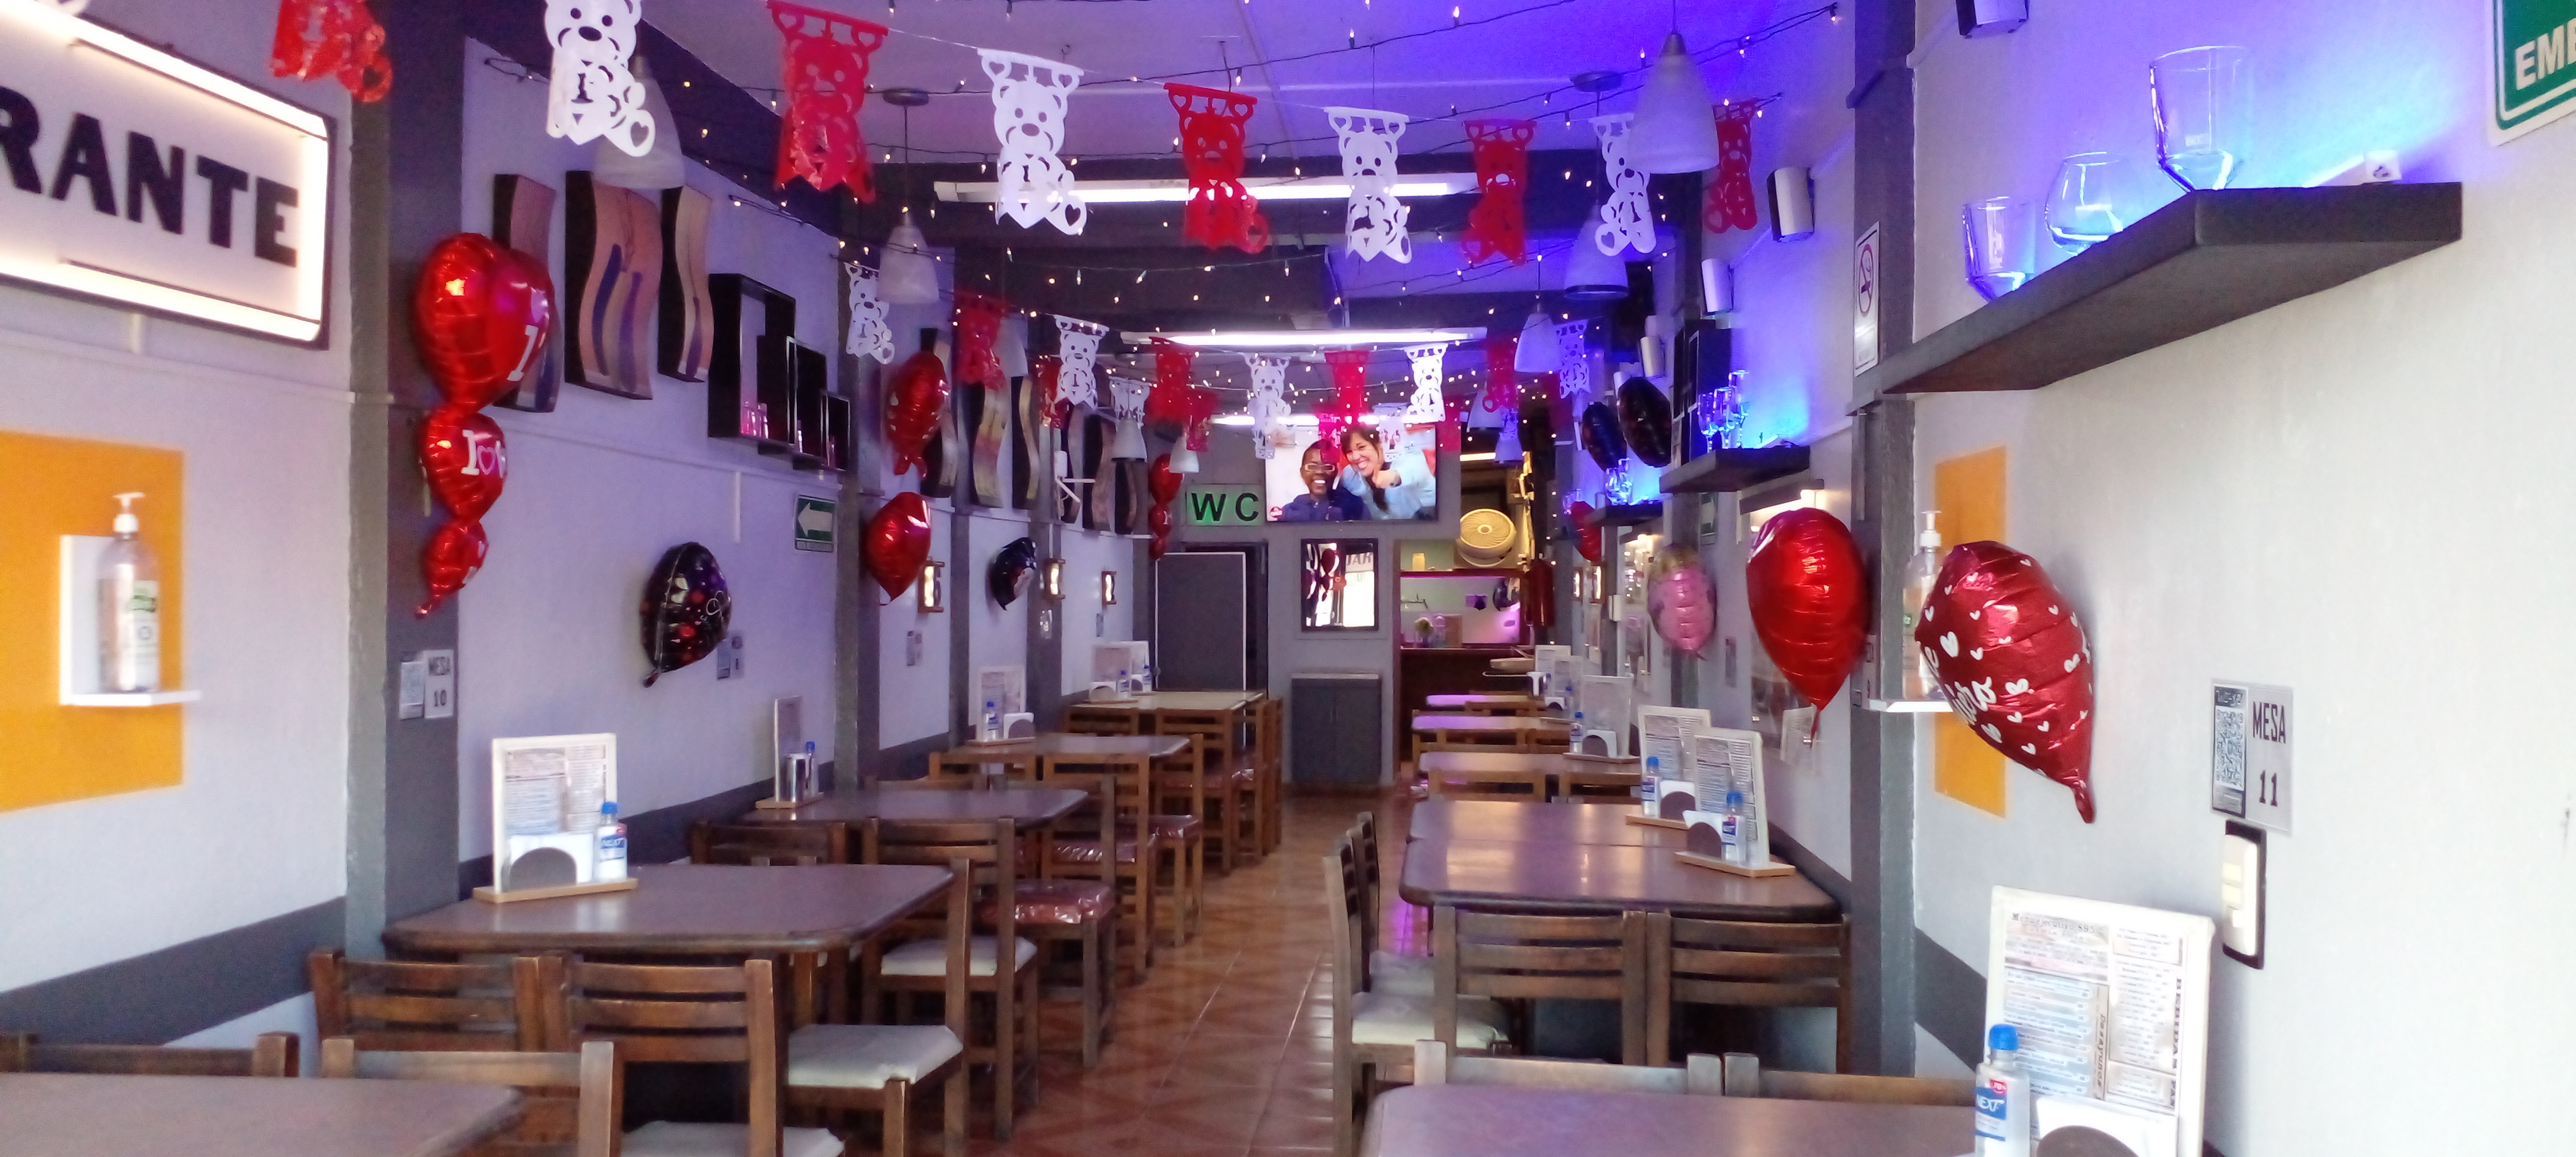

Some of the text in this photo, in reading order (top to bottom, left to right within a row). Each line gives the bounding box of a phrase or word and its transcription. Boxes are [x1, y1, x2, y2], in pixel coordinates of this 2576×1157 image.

[433, 689, 448, 707] 10
[2252, 701, 2287, 744] MESA
[2258, 770, 2279, 807] 11
